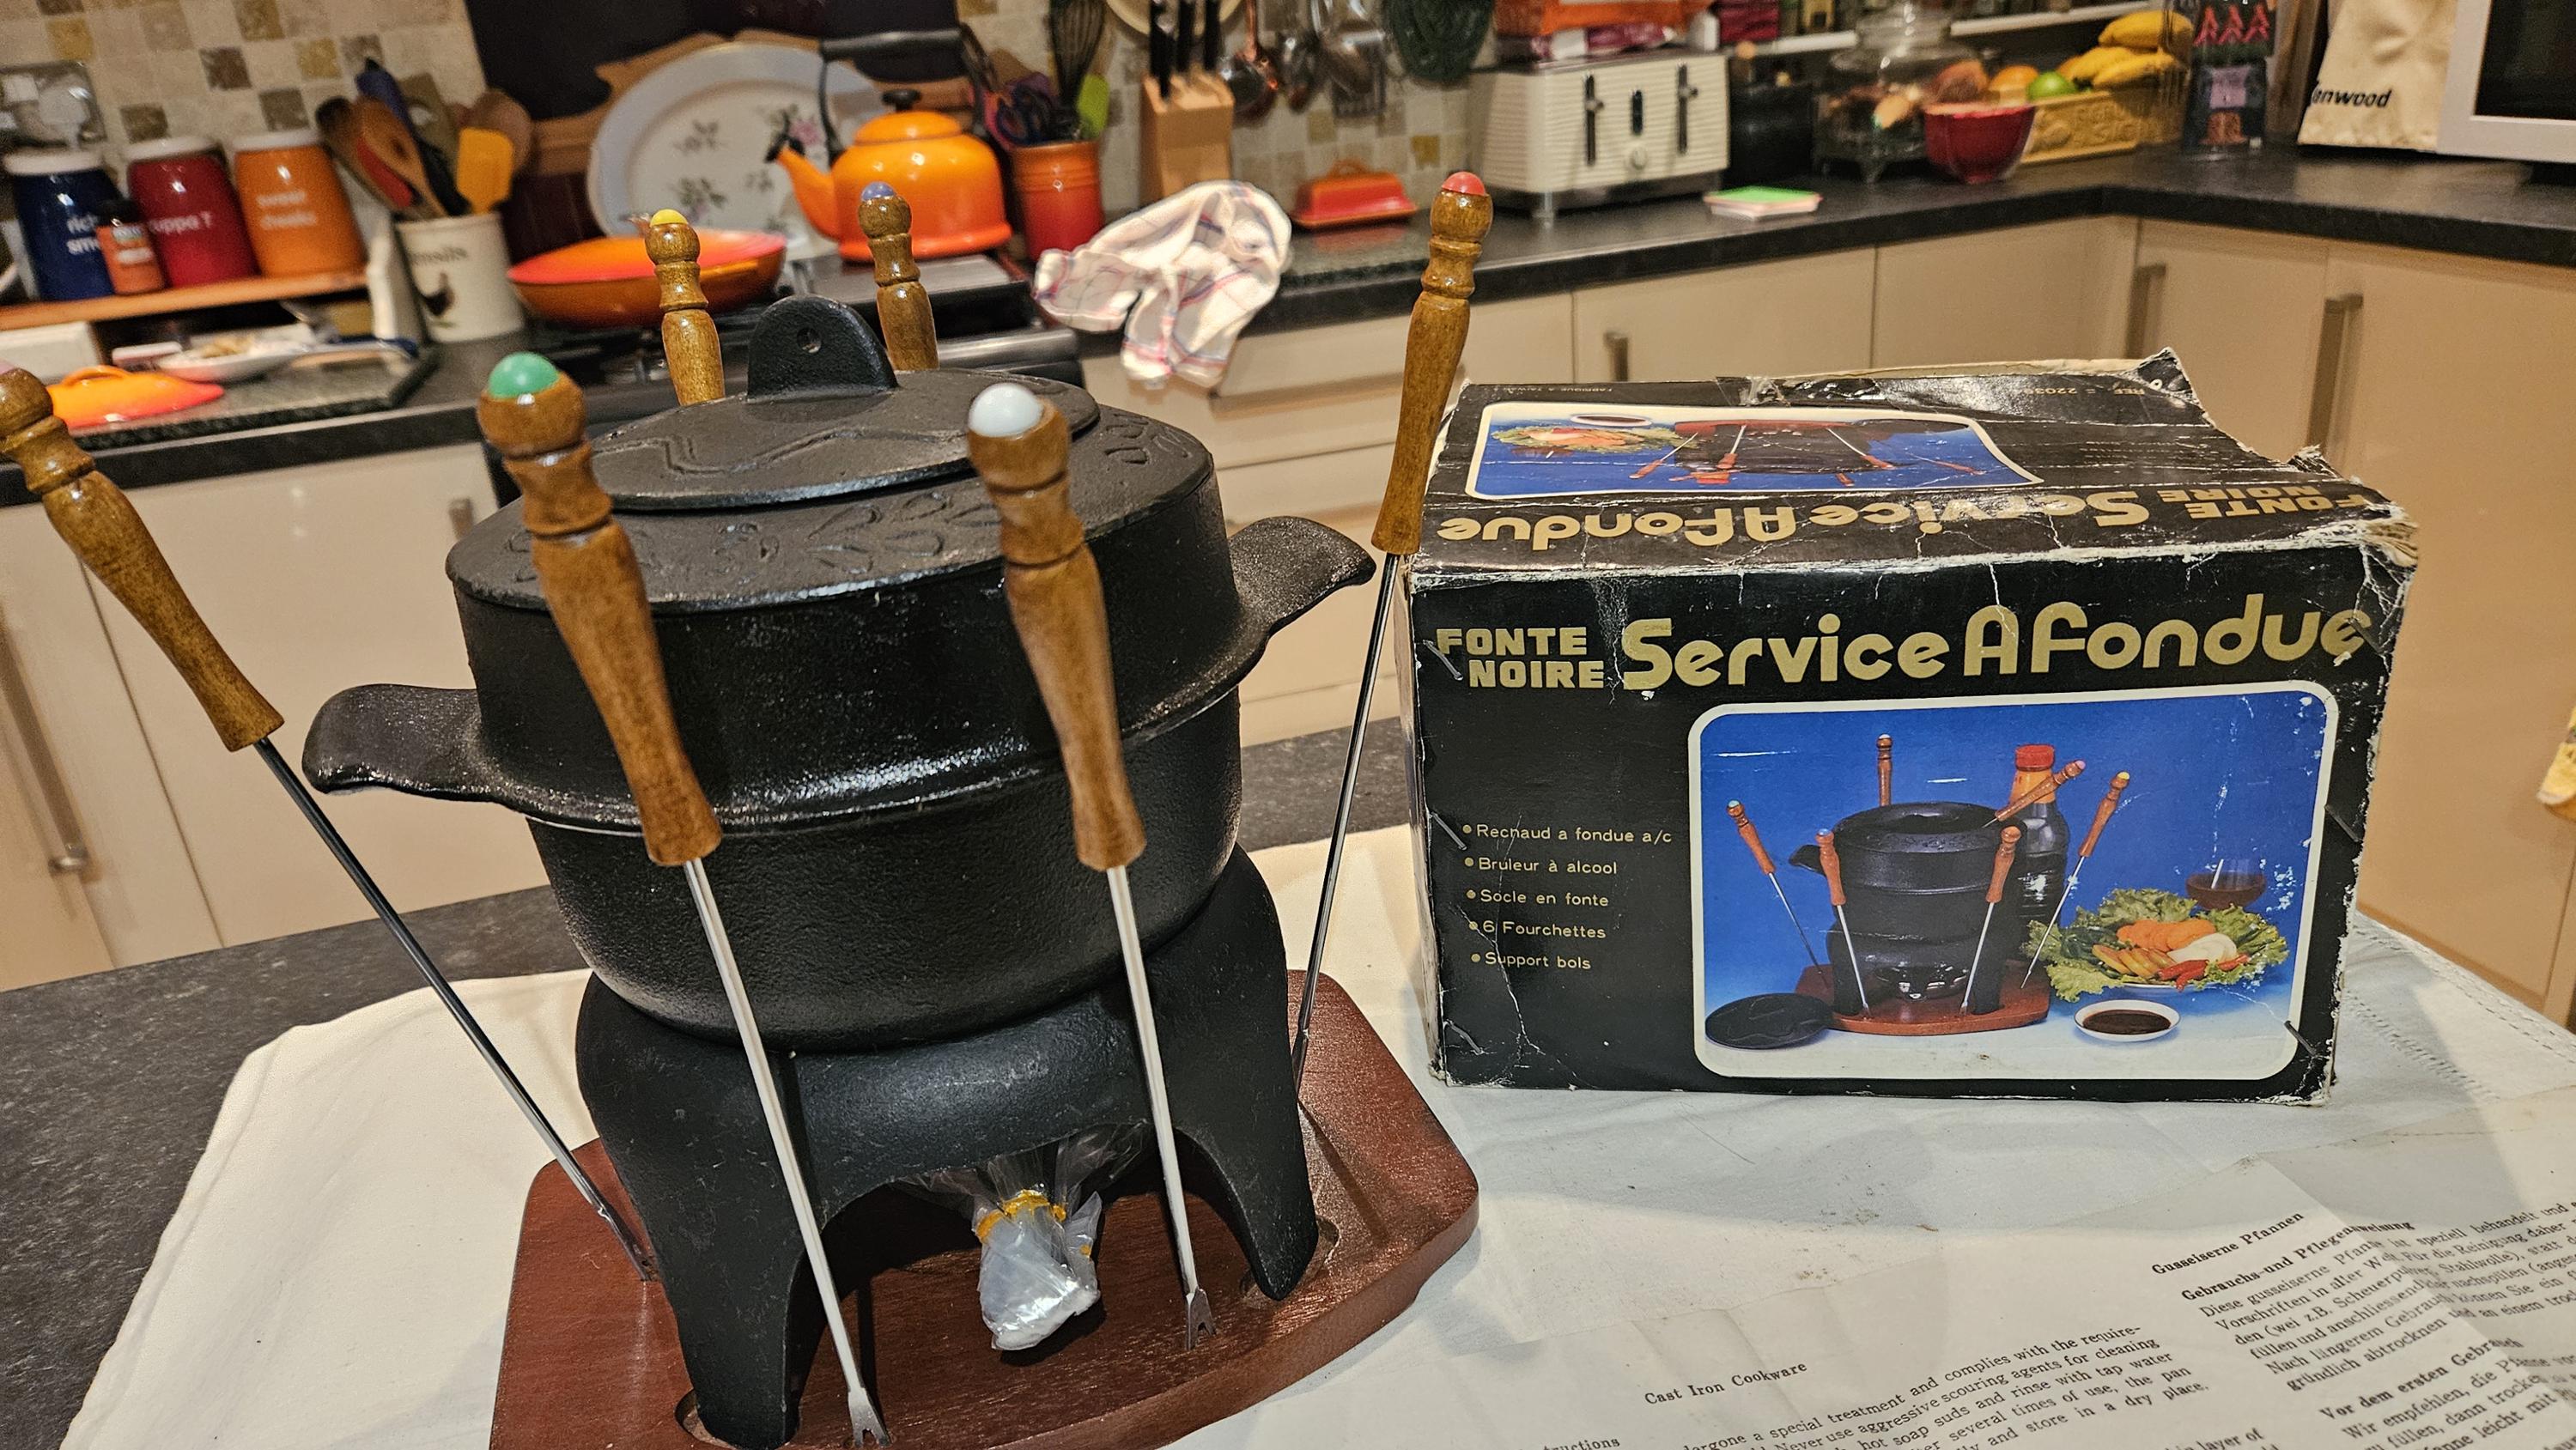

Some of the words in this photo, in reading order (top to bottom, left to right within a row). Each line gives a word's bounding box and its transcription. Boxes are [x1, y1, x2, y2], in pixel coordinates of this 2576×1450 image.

[2312, 89, 2391, 108] enwood
[1810, 491, 2151, 534] Service
[2158, 485, 2324, 503] NOIRE
[2184, 494, 2367, 519] FONTE
[1436, 627, 1588, 658] FONTE
[1624, 613, 1950, 690] Service
[1468, 659, 1606, 689] NOIRE
[1558, 830, 1568, 841] a
[1575, 827, 1634, 843] fondue
[1642, 829, 1673, 846] a/c
[1479, 858, 1540, 871] Bruleur
[1548, 859, 1558, 873] à
[1567, 860, 1617, 875] alcool
[1480, 889, 1527, 904] Socle
[1536, 894, 1556, 904] en
[1565, 892, 1609, 907] fonte
[1482, 920, 1496, 933] 6
[1503, 921, 1607, 939] Fourchettes
[1485, 951, 1550, 968] Support
[1557, 956, 1591, 970] bols
[2152, 1242, 2239, 1274] Gusseiserne
[2239, 1212, 2305, 1245] Pfannen
[2199, 1299, 2244, 1318] Diese
[2247, 1265, 2330, 1305] gusseiserne
[2415, 1228, 2469, 1247] speziell
[2470, 1211, 2539, 1235] behandelt
[2540, 1203, 2569, 1216] und
[2215, 1294, 2312, 1332] Vorschriften
[2308, 1286, 2330, 1299] in
[2330, 1268, 2364, 1289] aller
[2432, 1247, 2456, 1259] die
[2453, 1232, 2528, 1254] Reinigung
[2527, 1222, 2567, 1239] daher
[2234, 1331, 2264, 1346] den
[2264, 1316, 2301, 1338] (wei
[2304, 1305, 2333, 1322] z.B.
[2527, 1241, 2563, 1256] statt
[2250, 1339, 2298, 1359] füllen
[2296, 1327, 2327, 1344] und
[2326, 1278, 2427, 1333] anschliessend
[2451, 1266, 2529, 1289] nachspülen
[2265, 1353, 2311, 1374] Nach
[2309, 1326, 2385, 1361] längerem
[2452, 1288, 2508, 1304] können
[2506, 1283, 2535, 1297] Sie
[2539, 1277, 2565, 1289] ein
[2287, 1357, 2362, 1392] gründlich
[2363, 1317, 2448, 1362] abtrocknen
[2500, 1300, 2545, 1316] einem
[1644, 1388, 1683, 1404] Cast
[1687, 1382, 1725, 1397] Iron
[1731, 1362, 1808, 1386] Cookware
[1753, 1433, 1765, 1441] a
[1770, 1417, 1823, 1439] special
[1826, 1393, 1906, 1424] treatment
[1910, 1376, 1939, 1397] and
[1944, 1353, 2011, 1382] complies
[2014, 1345, 2050, 1362] with
[2050, 1338, 2079, 1352] the
[2081, 1326, 2142, 1345] require-
[1826, 1428, 1855, 1443] use
[1857, 1398, 1941, 1434] aggressive
[1941, 1373, 2009, 1404] scouring
[2011, 1358, 2063, 1380] agents
[2063, 1352, 2089, 1368] for
[2095, 1338, 2160, 1360] cleaning
[1857, 1438, 1889, 1450] hot
[1892, 1425, 1929, 1447] soap
[1934, 1404, 1971, 1427] suds
[1975, 1392, 2006, 1410] and
[2010, 1380, 2052, 1398] rinse
[2055, 1369, 2093, 1386] with
[2095, 1362, 2123, 1378] tap
[2129, 1351, 2173, 1369] water
[1948, 1411, 2008, 1442] several
[2011, 1396, 2057, 1417] times
[2062, 1390, 2079, 1403] of
[2085, 1382, 2119, 1398] use,
[2124, 1374, 2154, 1387] the
[2161, 1365, 2192, 1382] pan
[2319, 1403, 2356, 1420] Vor
[2358, 1390, 2395, 1409] dem
[2397, 1366, 2450, 1393] ersten
[2341, 1421, 2379, 1440] Wir
[2382, 1387, 2471, 1429] empfehlen,
[2470, 1371, 2498, 1389] die
[1987, 1427, 2019, 1447] and
[2026, 1412, 2069, 1433] store
[2076, 1405, 2096, 1419] in
[2104, 1401, 2117, 1412] a
[2124, 1392, 2154, 1408] dry
[2196, 1435, 2242, 1450] layer
[2245, 1427, 2265, 1442] of
[2387, 1423, 2445, 1449] füllen,
[2445, 1402, 2488, 1427] dann
[2472, 1410, 2525, 1439] leicht
[2526, 1392, 2558, 1414] mit
